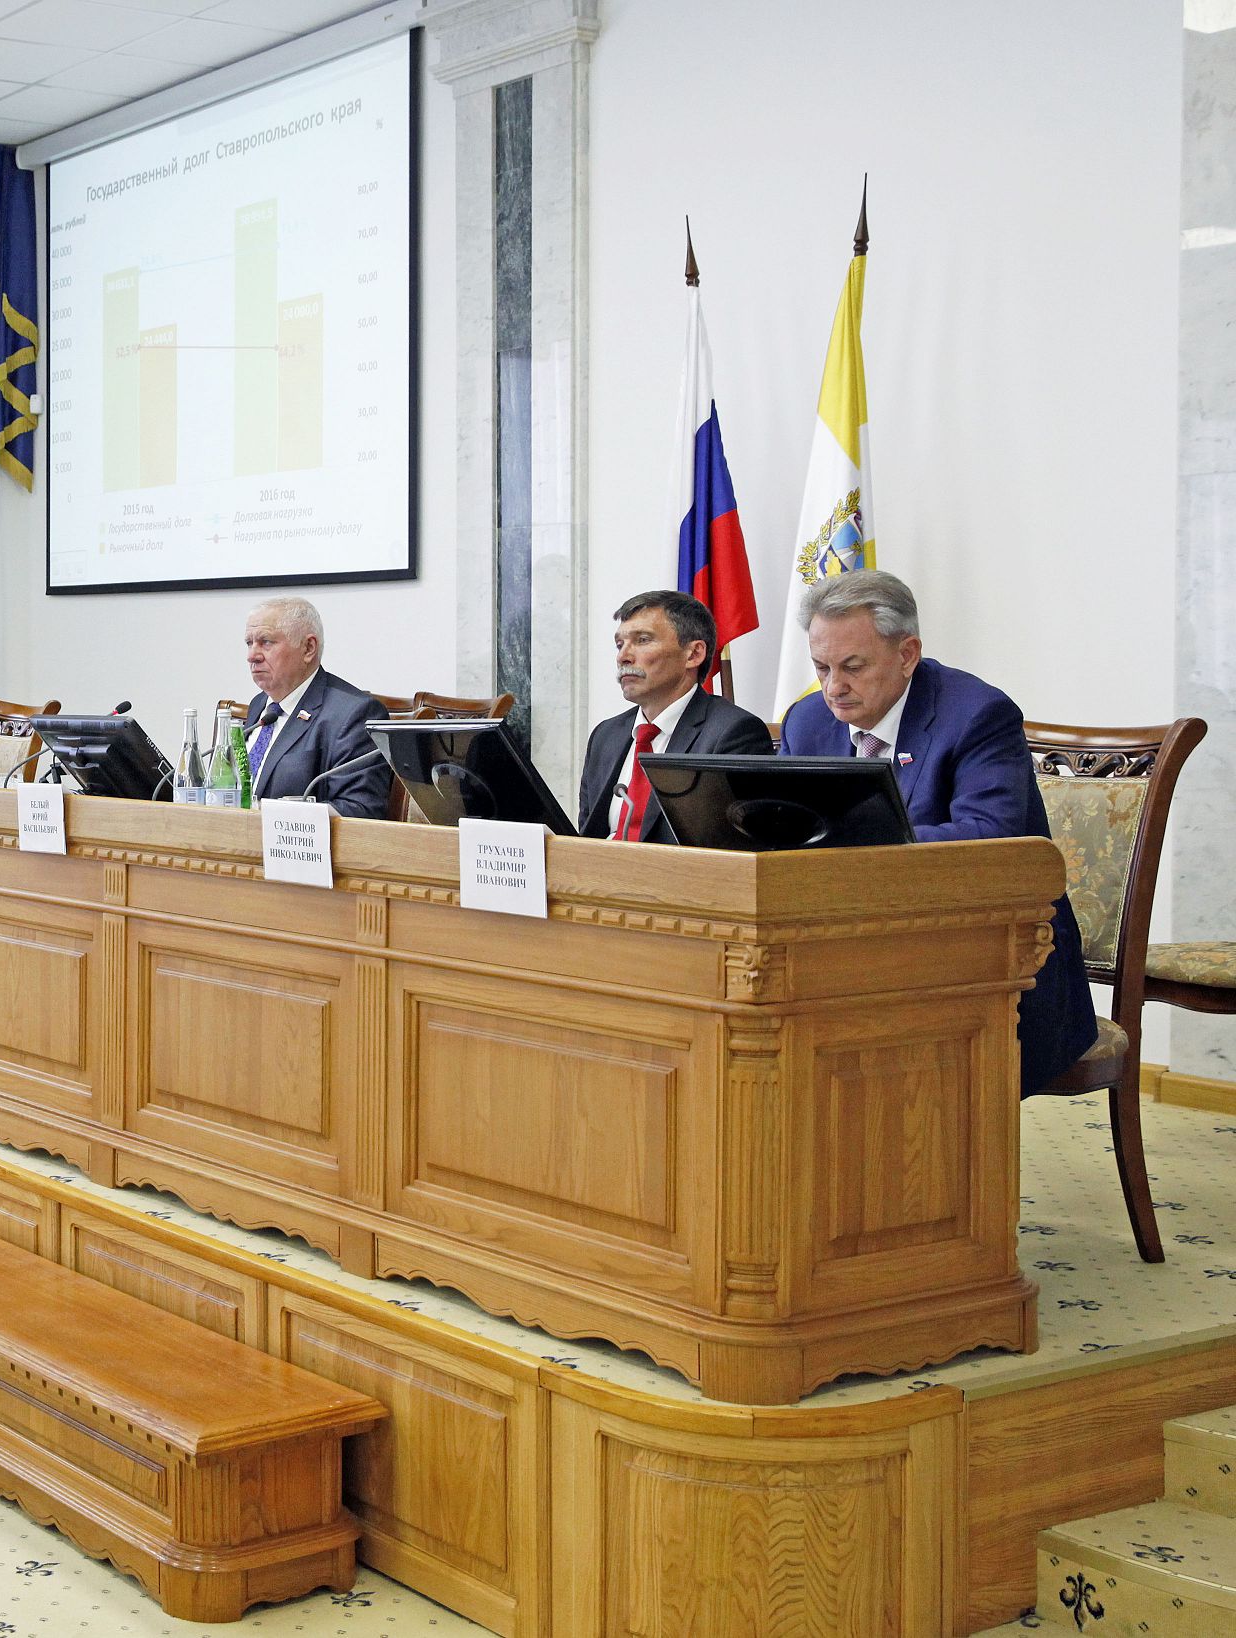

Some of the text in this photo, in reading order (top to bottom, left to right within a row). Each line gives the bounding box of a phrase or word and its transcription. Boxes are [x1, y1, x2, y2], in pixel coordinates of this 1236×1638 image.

[86, 98, 362, 202] Государственный долг Ставропольского края
[259, 489, 295, 502] 2016 год
[123, 504, 154, 516] 2015 год
[30, 800, 50, 810] БЕЛЫЙ
[32, 812, 48, 822] ЮРИЙ
[274, 820, 316, 834] СУДАВЦОВ
[276, 834, 314, 848] ДМИТРИЙ
[269, 848, 323, 863] НИКОЛАЕВИЧ
[477, 844, 525, 858] ТРУХАЧЕВ
[475, 859, 527, 874] ВЛАДИМИР
[476, 873, 527, 889] ИВАНОВИЧ
